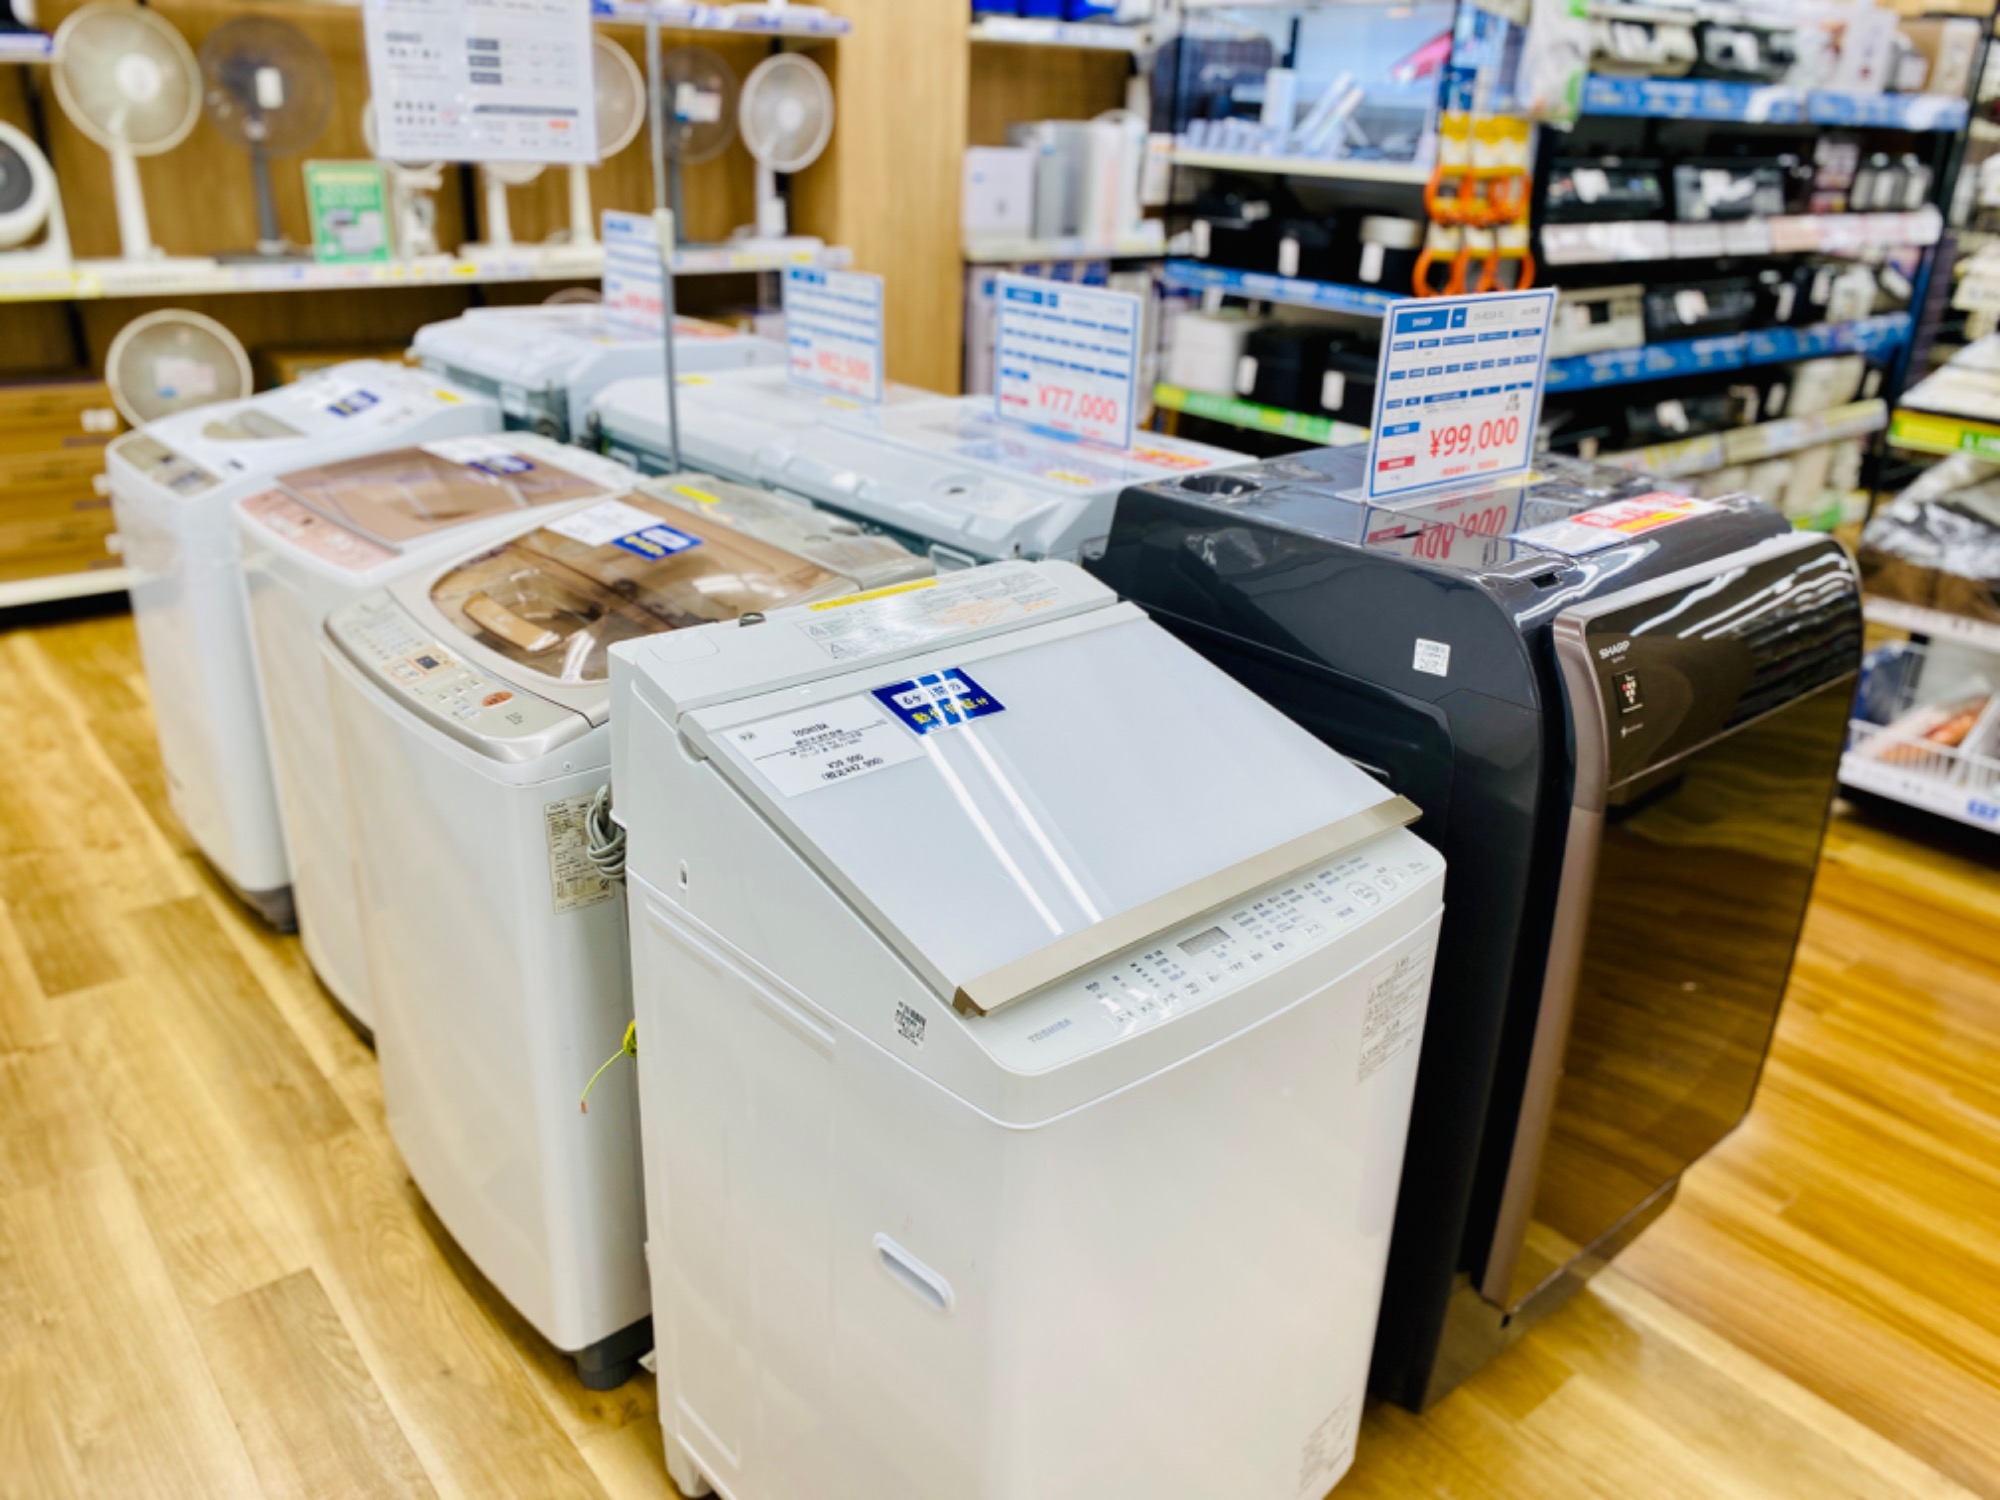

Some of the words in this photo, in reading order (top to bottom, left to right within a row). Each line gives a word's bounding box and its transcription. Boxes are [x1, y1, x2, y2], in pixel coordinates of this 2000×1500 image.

[1038, 383, 1118, 425] ¥77,000
[1429, 416, 1519, 459] ¥99,000
[1598, 640, 1631, 660] SHARP
[1027, 1017, 1073, 1043] TOSHIBA
